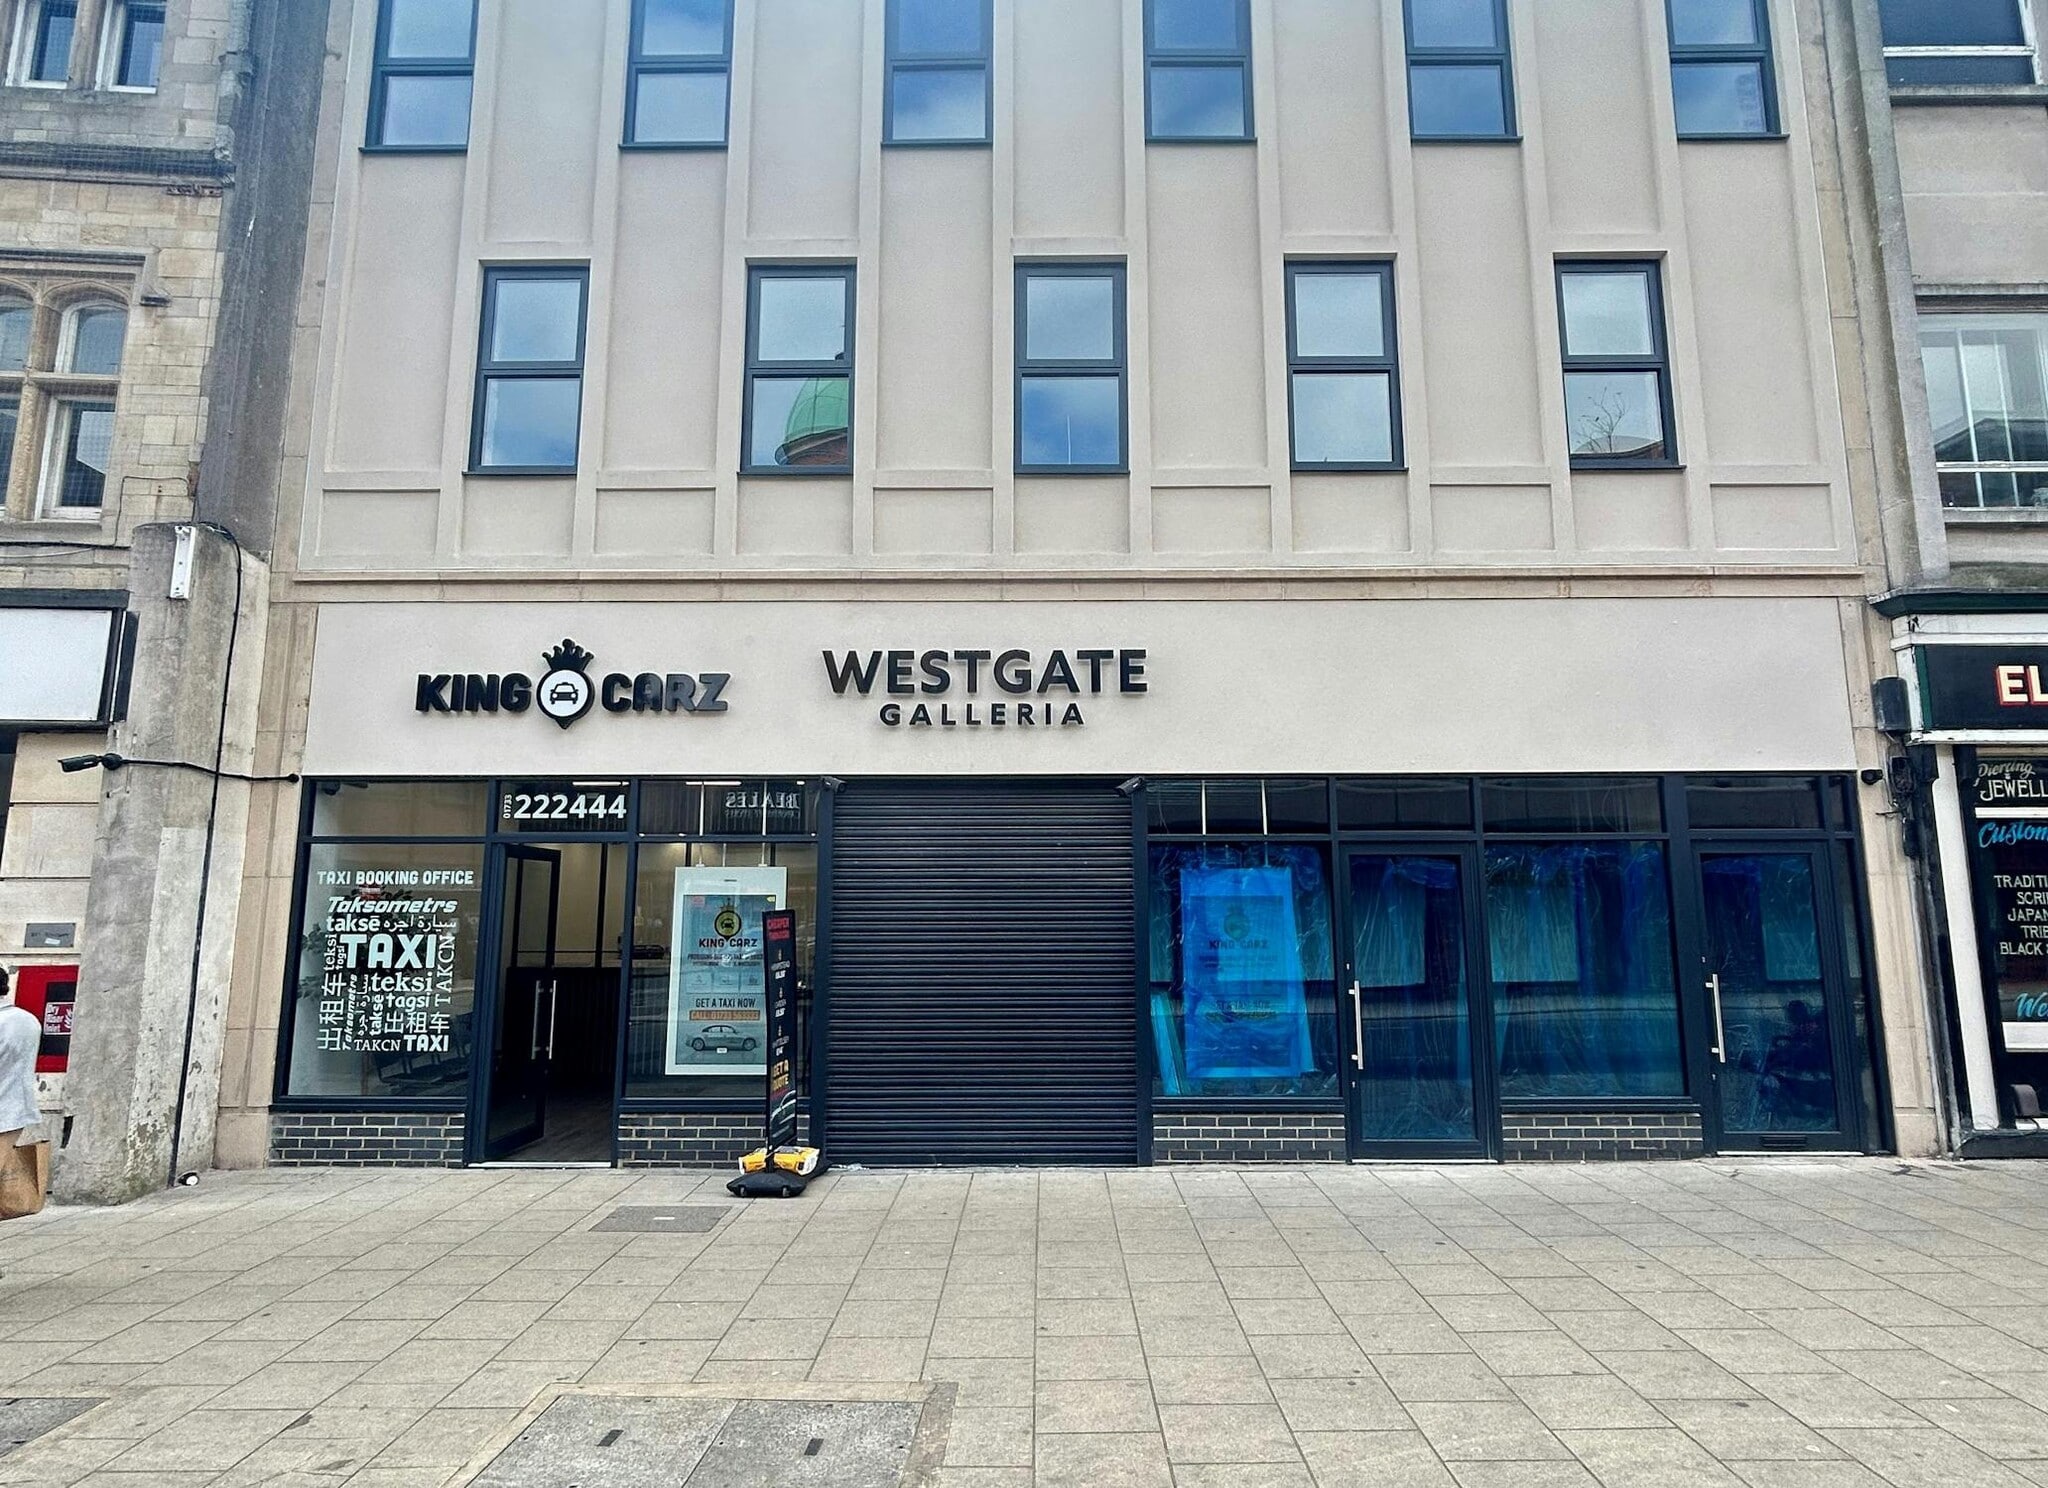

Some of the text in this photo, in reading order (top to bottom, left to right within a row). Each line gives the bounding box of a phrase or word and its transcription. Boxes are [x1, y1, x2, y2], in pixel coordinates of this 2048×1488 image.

[822, 649, 1148, 694] WESTGATE
[415, 672, 731, 713] KING CARZ
[1995, 664, 2048, 706] EL
[879, 702, 1084, 727] GALLERIA
[1980, 779, 2048, 801] JEWELL
[502, 794, 627, 819] 01733 222444
[1978, 820, 2048, 848] Custom
[317, 870, 474, 885] TAXI BOOKING OFFICE
[328, 896, 458, 913] Taksometrs
[323, 933, 337, 971] teksi
[339, 933, 437, 969] TAXI
[698, 938, 757, 948] KING CARZ
[2000, 942, 2044, 955] BLACK
[371, 971, 433, 993] teksi
[316, 972, 347, 1051] 出租车
[342, 973, 357, 1051] Taksometrs
[386, 992, 430, 1012] tagsi
[695, 998, 756, 1008] GET A TAXI NOW
[384, 1010, 450, 1034] 出租车
[403, 1034, 449, 1052] TAXI
